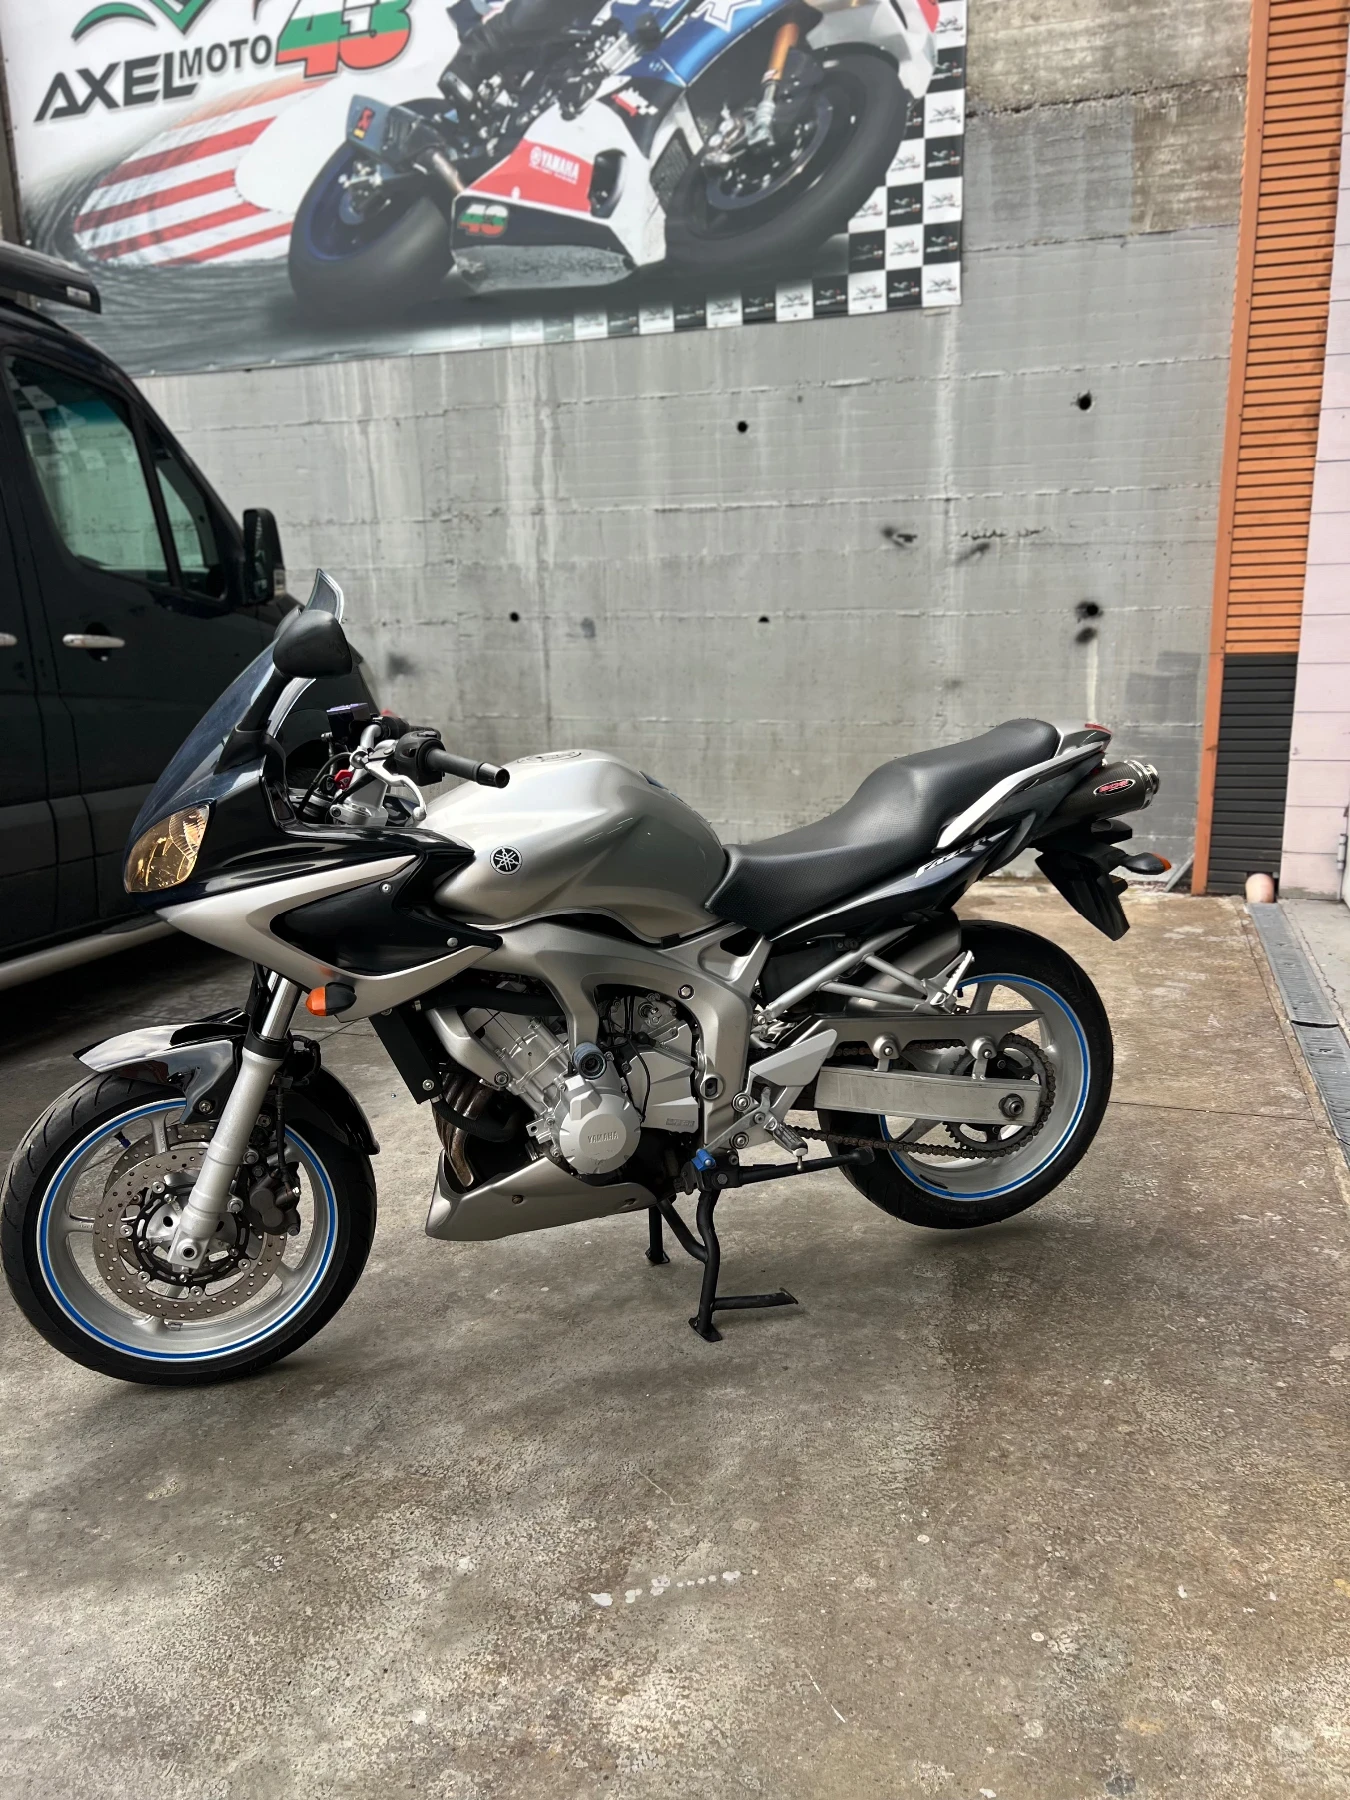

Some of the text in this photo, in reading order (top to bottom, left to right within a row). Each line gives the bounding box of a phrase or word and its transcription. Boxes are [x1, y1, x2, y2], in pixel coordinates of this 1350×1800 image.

[33, 0, 412, 123] AXEL MOTO 43
[540, 149, 580, 181] YAMAHA
[587, 1130, 619, 1144] YAMAHA
